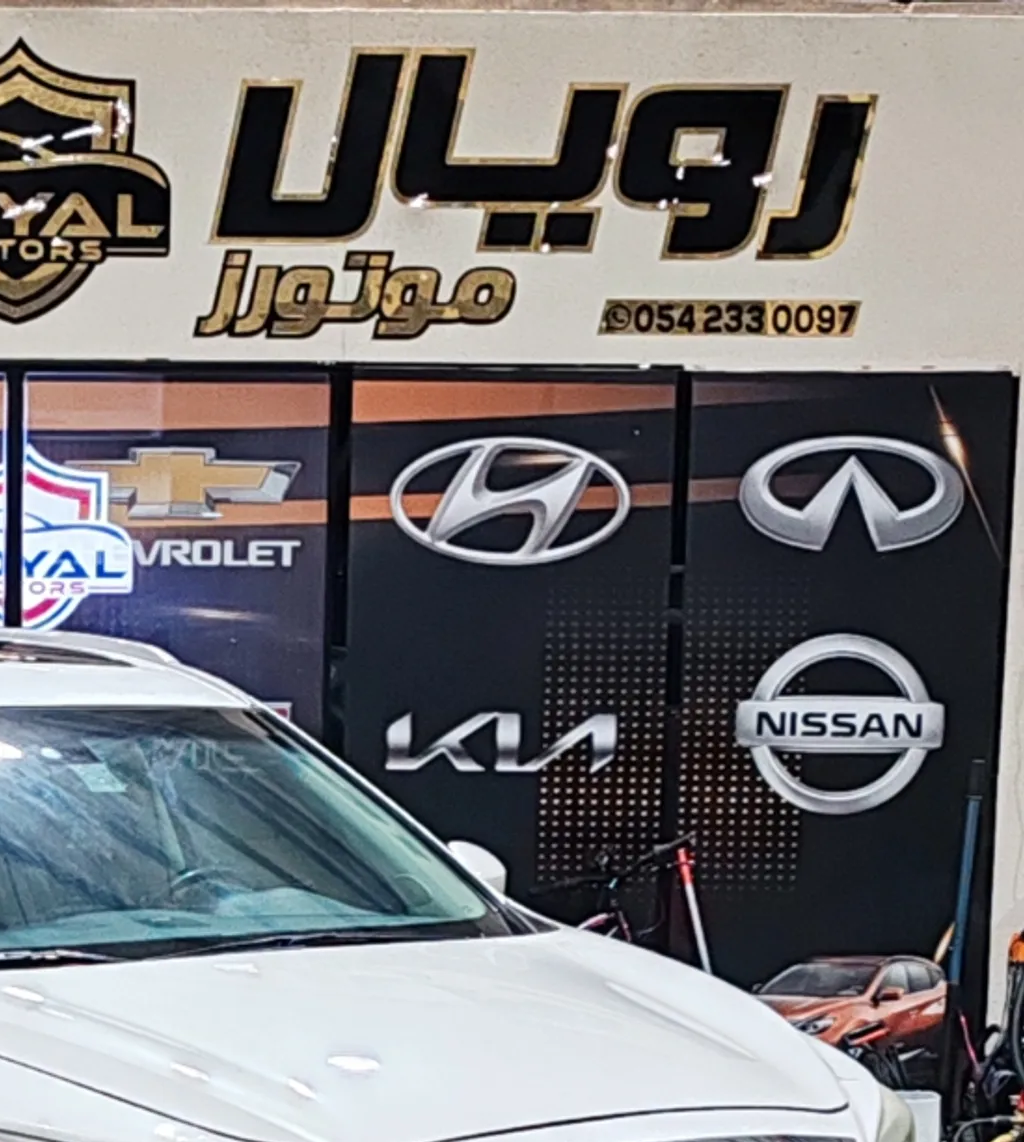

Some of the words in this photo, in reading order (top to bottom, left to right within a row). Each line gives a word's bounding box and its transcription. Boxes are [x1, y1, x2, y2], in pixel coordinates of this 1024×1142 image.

[209, 46, 879, 260] رويال
[193, 250, 517, 338] موتورز
[133, 539, 302, 567] VROLET
[755, 711, 923, 738] NISSAN
